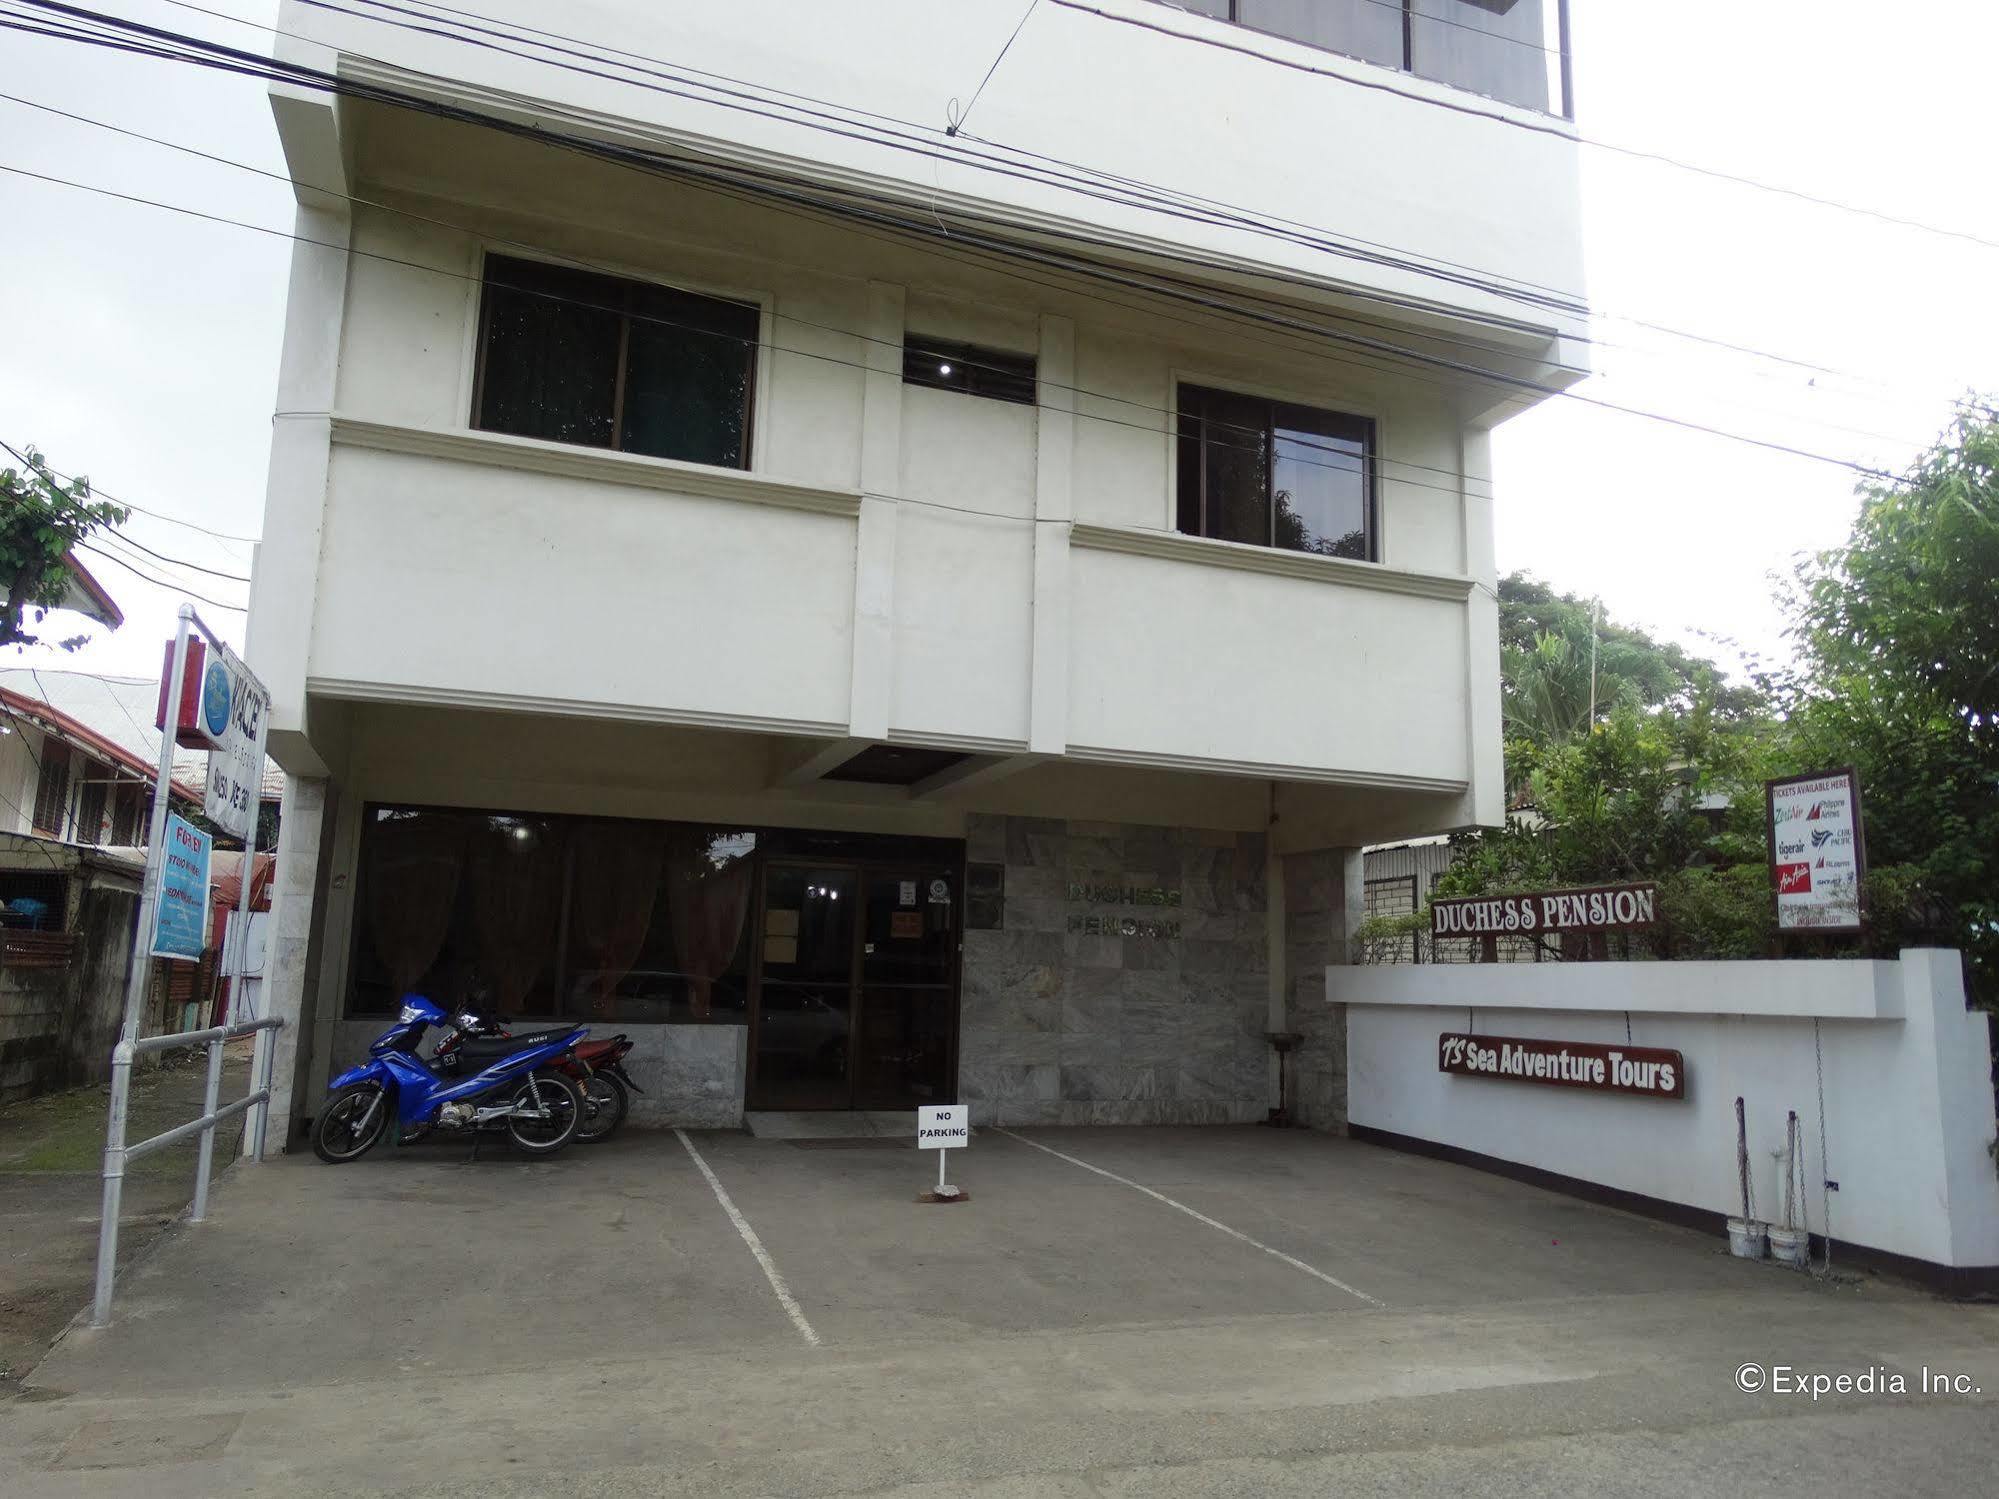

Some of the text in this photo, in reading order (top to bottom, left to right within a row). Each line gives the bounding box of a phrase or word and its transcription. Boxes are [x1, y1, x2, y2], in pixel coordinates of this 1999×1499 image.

[1773, 786, 1796, 798] TICKETS
[1797, 782, 1830, 795] AVAILABLE
[1433, 889, 1656, 934] DUCHESS PENSION
[1466, 1043, 1497, 1073] Sea
[1500, 1044, 1606, 1084] Adventure
[1609, 1052, 1677, 1093] Tours
[936, 1112, 951, 1120] NO
[919, 1128, 967, 1138] PARKING
